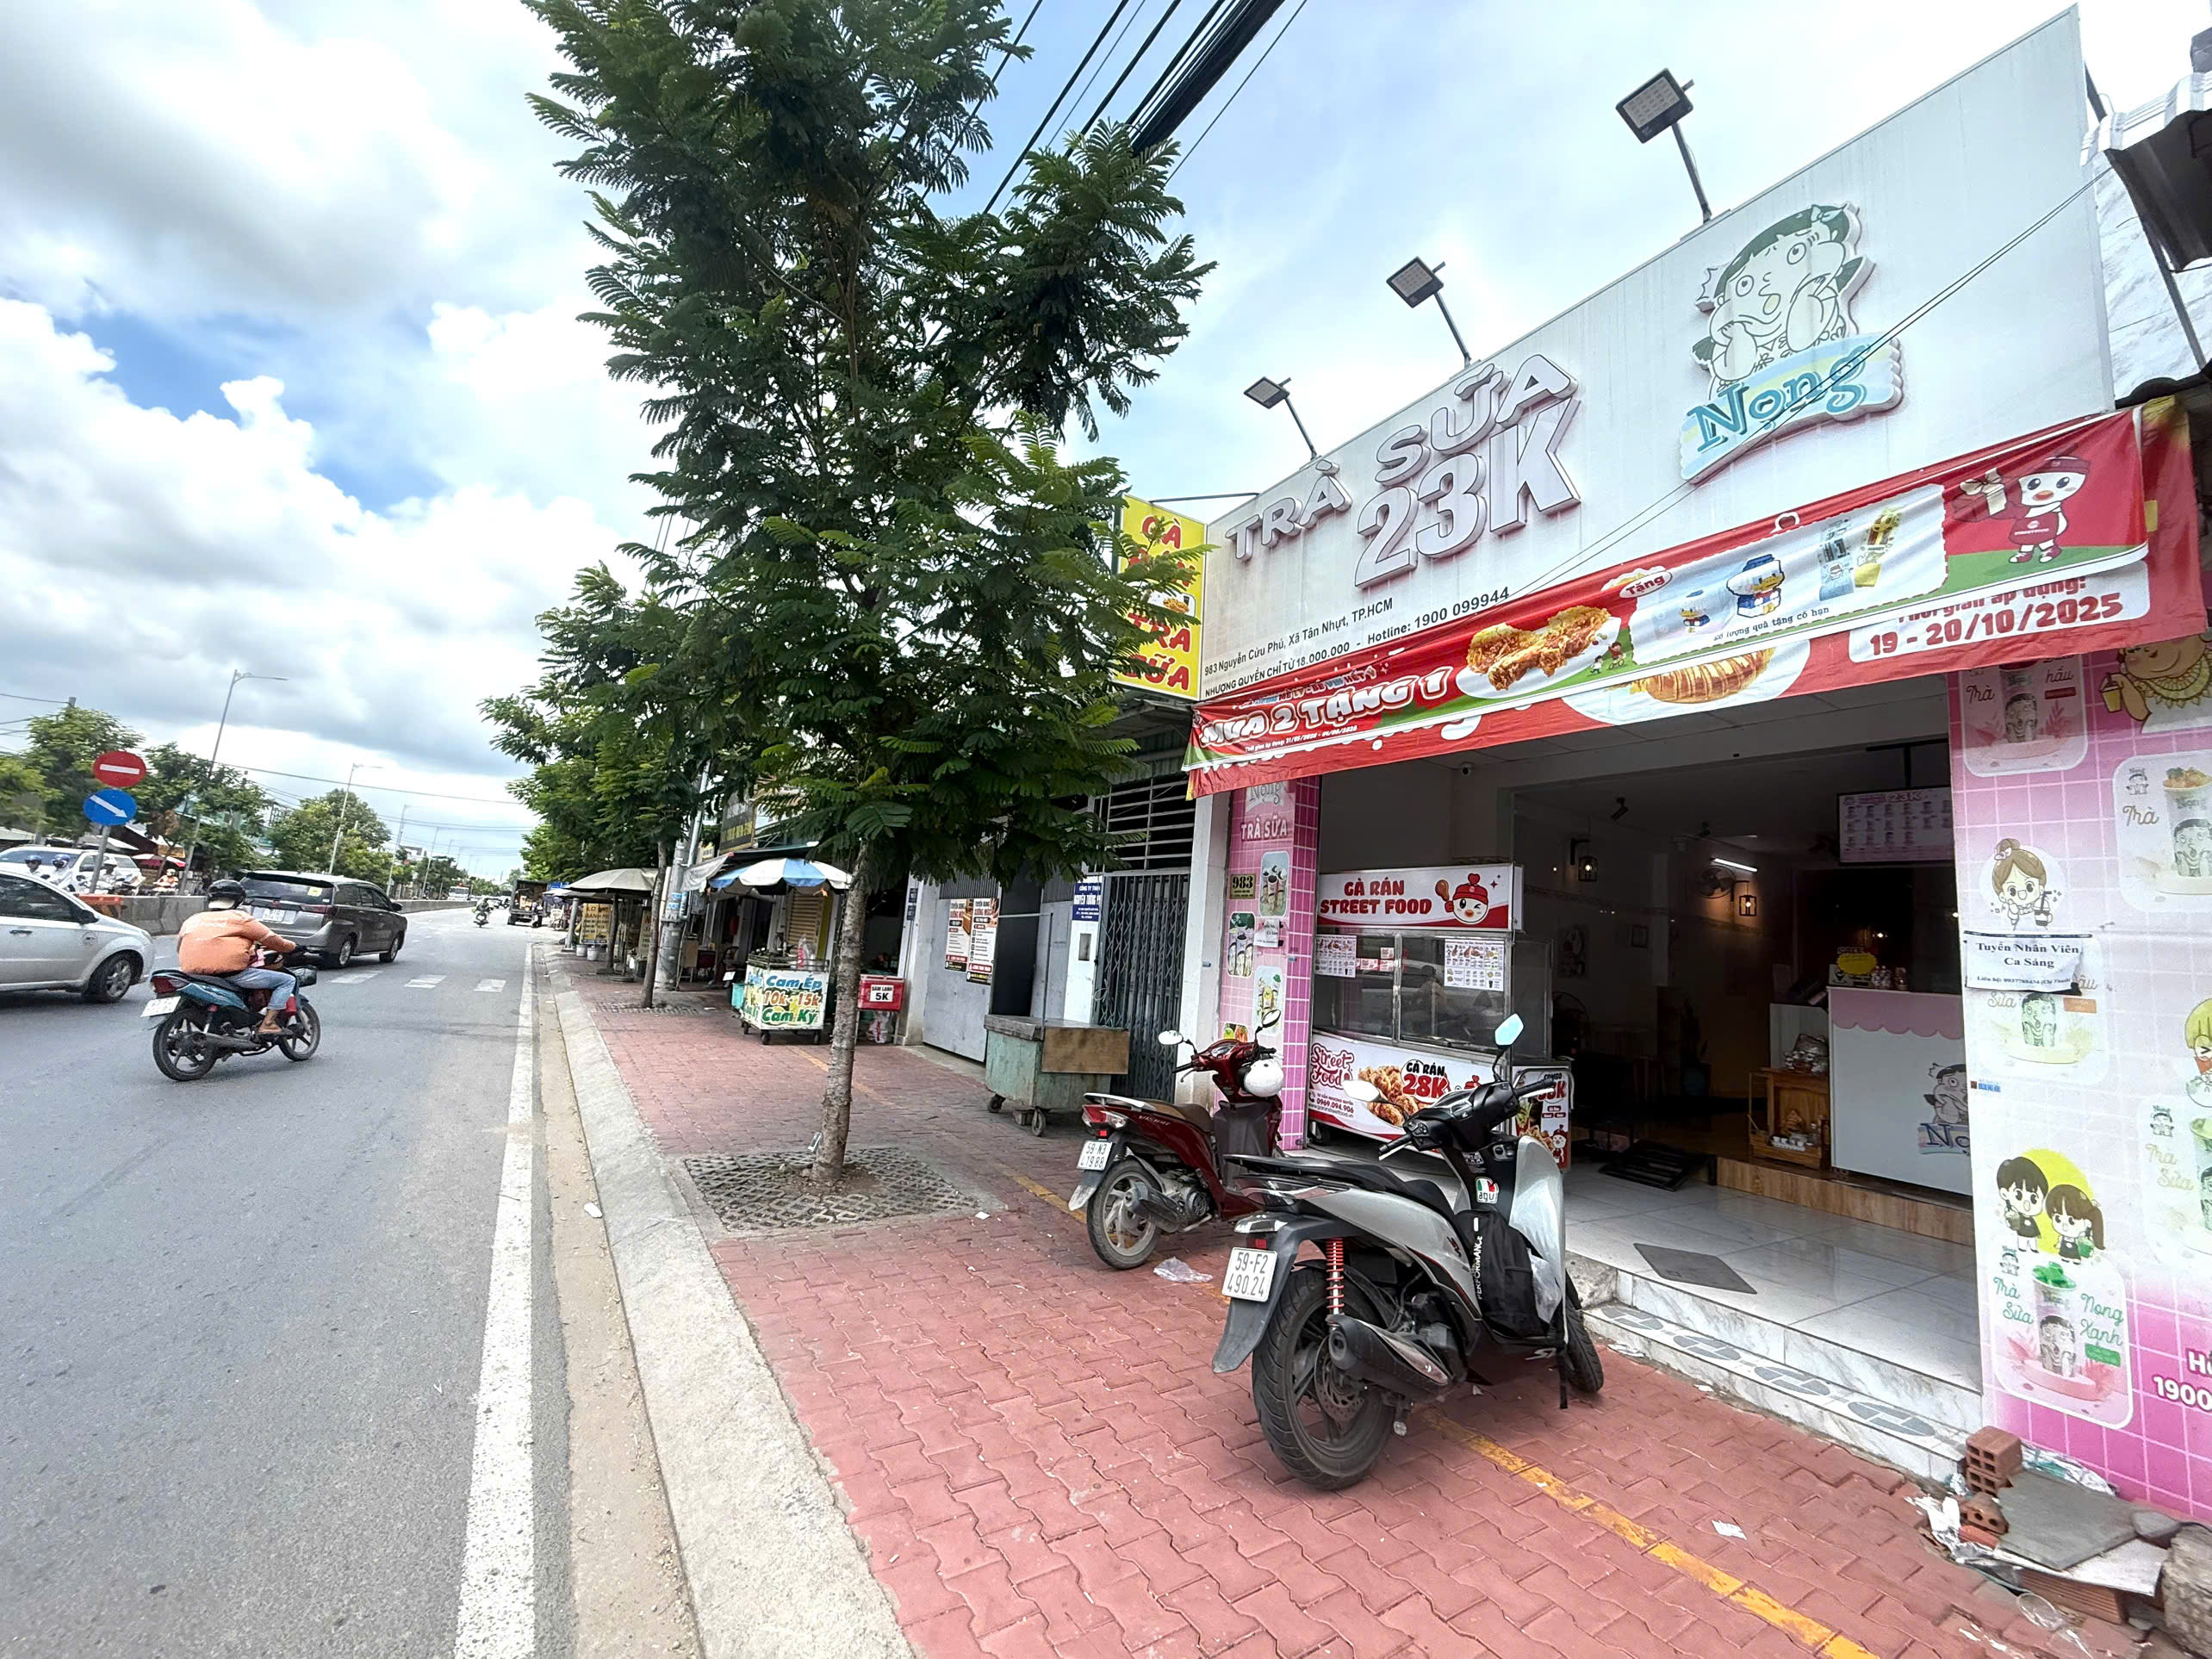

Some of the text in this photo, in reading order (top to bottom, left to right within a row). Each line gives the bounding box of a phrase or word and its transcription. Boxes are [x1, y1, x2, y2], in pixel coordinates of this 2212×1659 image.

[1225, 354, 1578, 561] TRÀ SỮA
[1354, 397, 1581, 588] 23K
[1626, 575, 1665, 598] Tặng
[1752, 621, 1769, 632] quà
[1771, 615, 1793, 626] tặng
[1796, 610, 1808, 620] có
[1811, 606, 1830, 618] hạn
[1870, 631, 1898, 656] 19
[1926, 592, 2123, 646] 20/10/2025
[1205, 662, 1218, 676] 983
[1218, 651, 1247, 671] Nguyễn
[1288, 633, 1301, 648] Xã
[1302, 625, 1320, 642] Tân
[1321, 615, 1349, 634] Nhựt,
[1352, 597, 1394, 623] TP.HCM
[1205, 680, 1237, 698] NHƯỢNG
[1238, 668, 1266, 687] QUYỀN
[1266, 661, 1283, 678] CHỈ
[1283, 656, 1296, 671] TỪ
[1296, 642, 1351, 668] 18.000.000
[1368, 623, 1411, 644] Hotline:
[1414, 607, 1448, 629] 1900
[1452, 586, 1509, 617] 099944
[1966, 684, 1996, 704] Trà
[1201, 711, 1269, 747] MUA
[1270, 704, 1298, 735] 2
[1421, 666, 1454, 700] 1
[1241, 814, 1288, 841] TRÀ SỮA
[2122, 805, 2159, 827] Trà
[1233, 875, 1253, 889] 983
[1344, 876, 1405, 897] GÀ RÁN
[1320, 898, 1432, 915] STREET FOOD
[2015, 944, 2047, 953] Nhân
[2051, 945, 2078, 954] Viên
[2004, 957, 2054, 968] Ca Sáng
[767, 974, 823, 990] Cam Ép
[765, 991, 786, 1005] 10k
[798, 992, 820, 1006] 15k
[762, 1008, 794, 1022] Cam
[1311, 1046, 1352, 1069] Street
[1406, 1060, 1445, 1077] GÀ RÁN
[1312, 1066, 1343, 1086] Food
[1402, 1073, 1448, 1099] 28K
[1474, 1235, 1483, 1301] PERFORMANCE
[1227, 1274, 1265, 1297] 490.24
[1993, 1277, 2021, 1299] Trà
[2080, 1293, 2124, 1327] Nọng
[2079, 1319, 2123, 1346] Xanh
[2153, 1376, 2212, 1410] 1900
